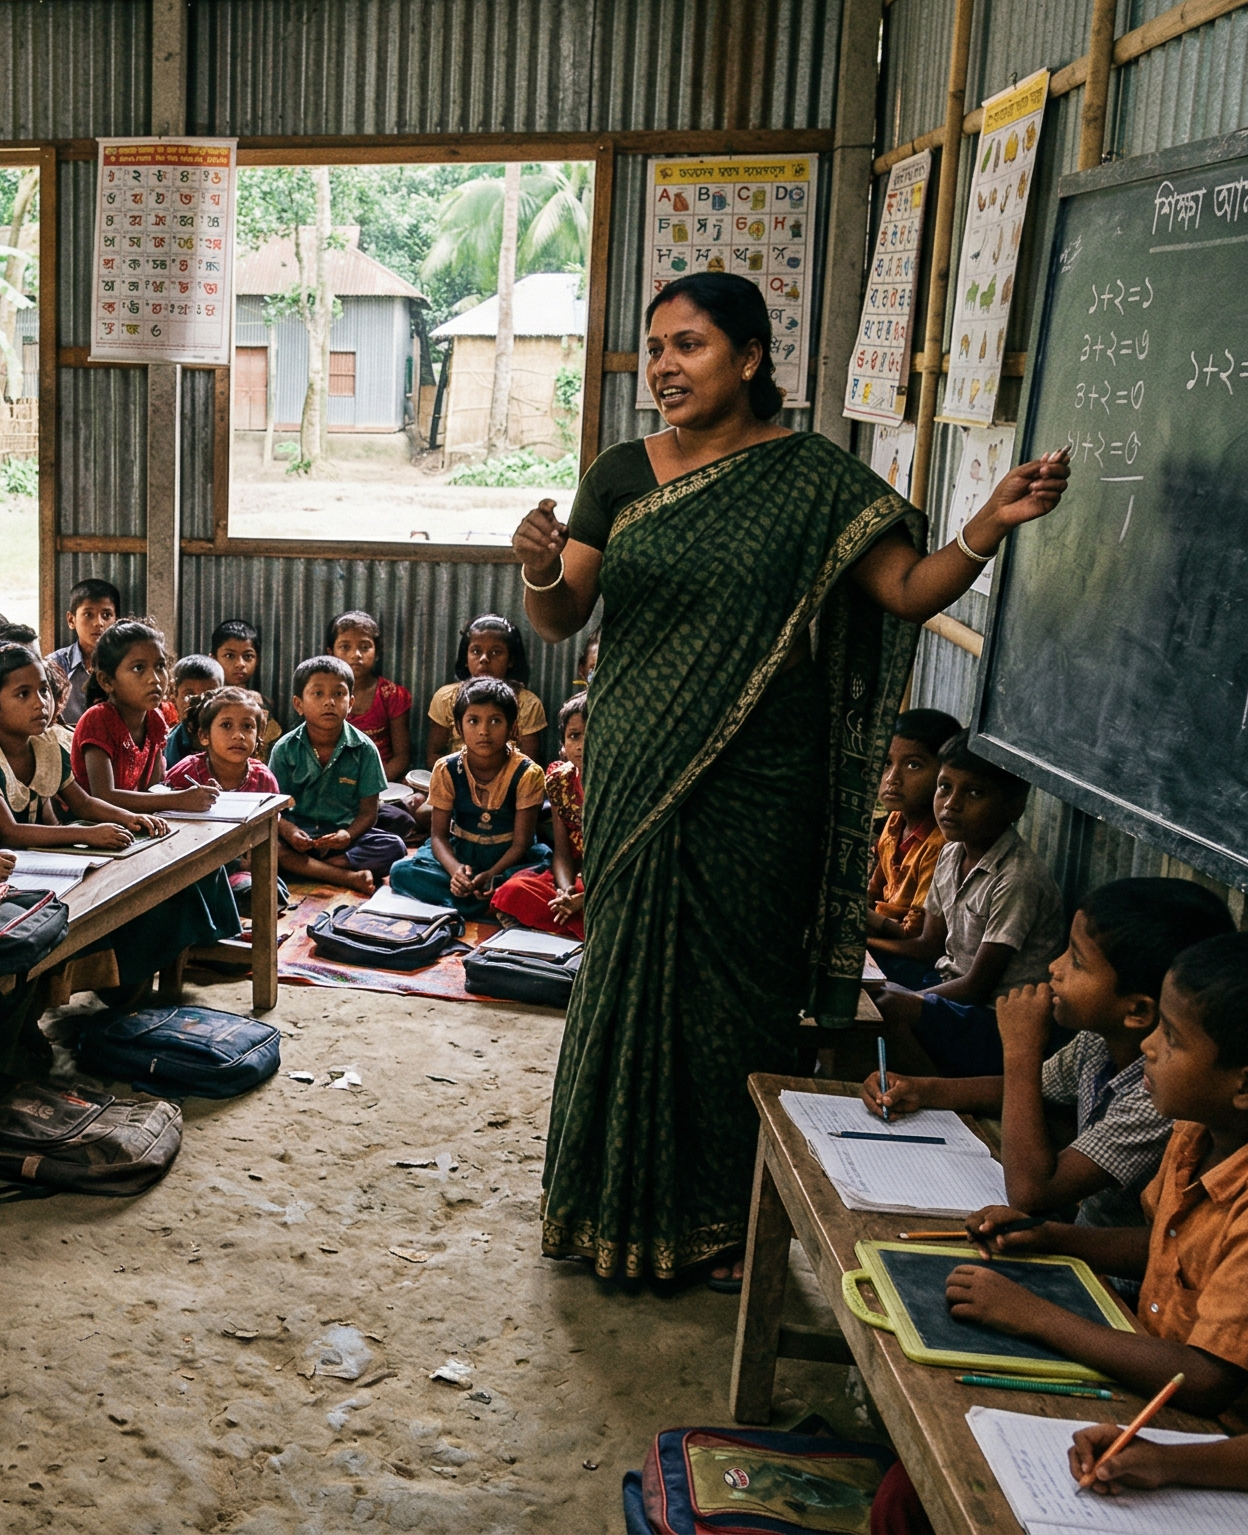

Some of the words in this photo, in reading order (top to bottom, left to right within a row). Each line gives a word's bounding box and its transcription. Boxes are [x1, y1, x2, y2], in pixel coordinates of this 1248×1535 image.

[658, 188, 671, 202] A
[698, 187, 710, 201] B
[737, 186, 750, 201] C
[775, 186, 788, 200] D
